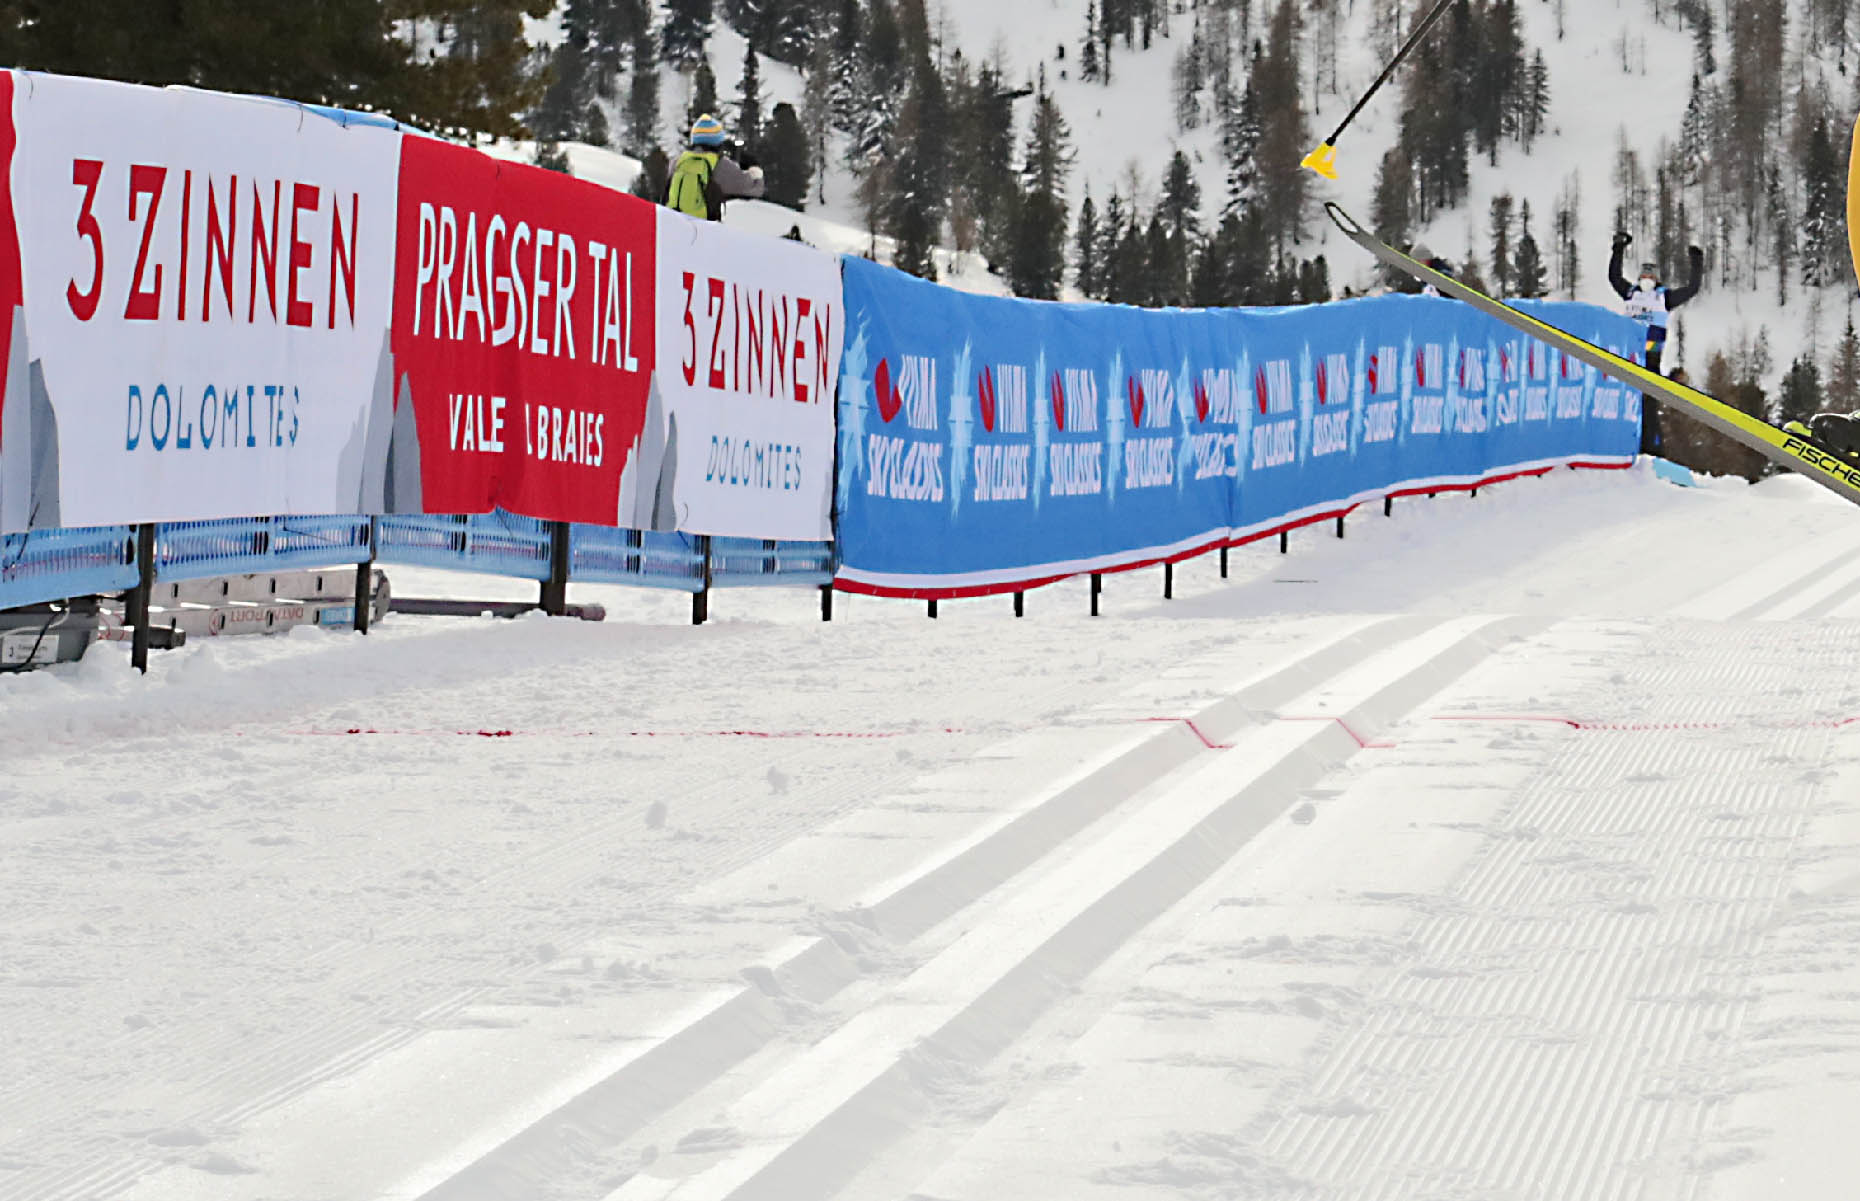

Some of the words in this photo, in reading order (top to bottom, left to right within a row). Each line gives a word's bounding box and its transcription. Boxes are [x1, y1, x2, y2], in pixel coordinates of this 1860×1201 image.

[66, 159, 104, 321] 3
[124, 164, 359, 332] ZINNEN
[413, 202, 577, 360] PRAGSER
[588, 240, 639, 373] TAL
[682, 271, 696, 387] 3
[707, 276, 831, 405] ZINNEN
[126, 383, 299, 451] DOLOMITES
[538, 404, 604, 467] BRAIES
[706, 435, 801, 492] DOLOMITES
[231, 606, 304, 622] DATAPORT
